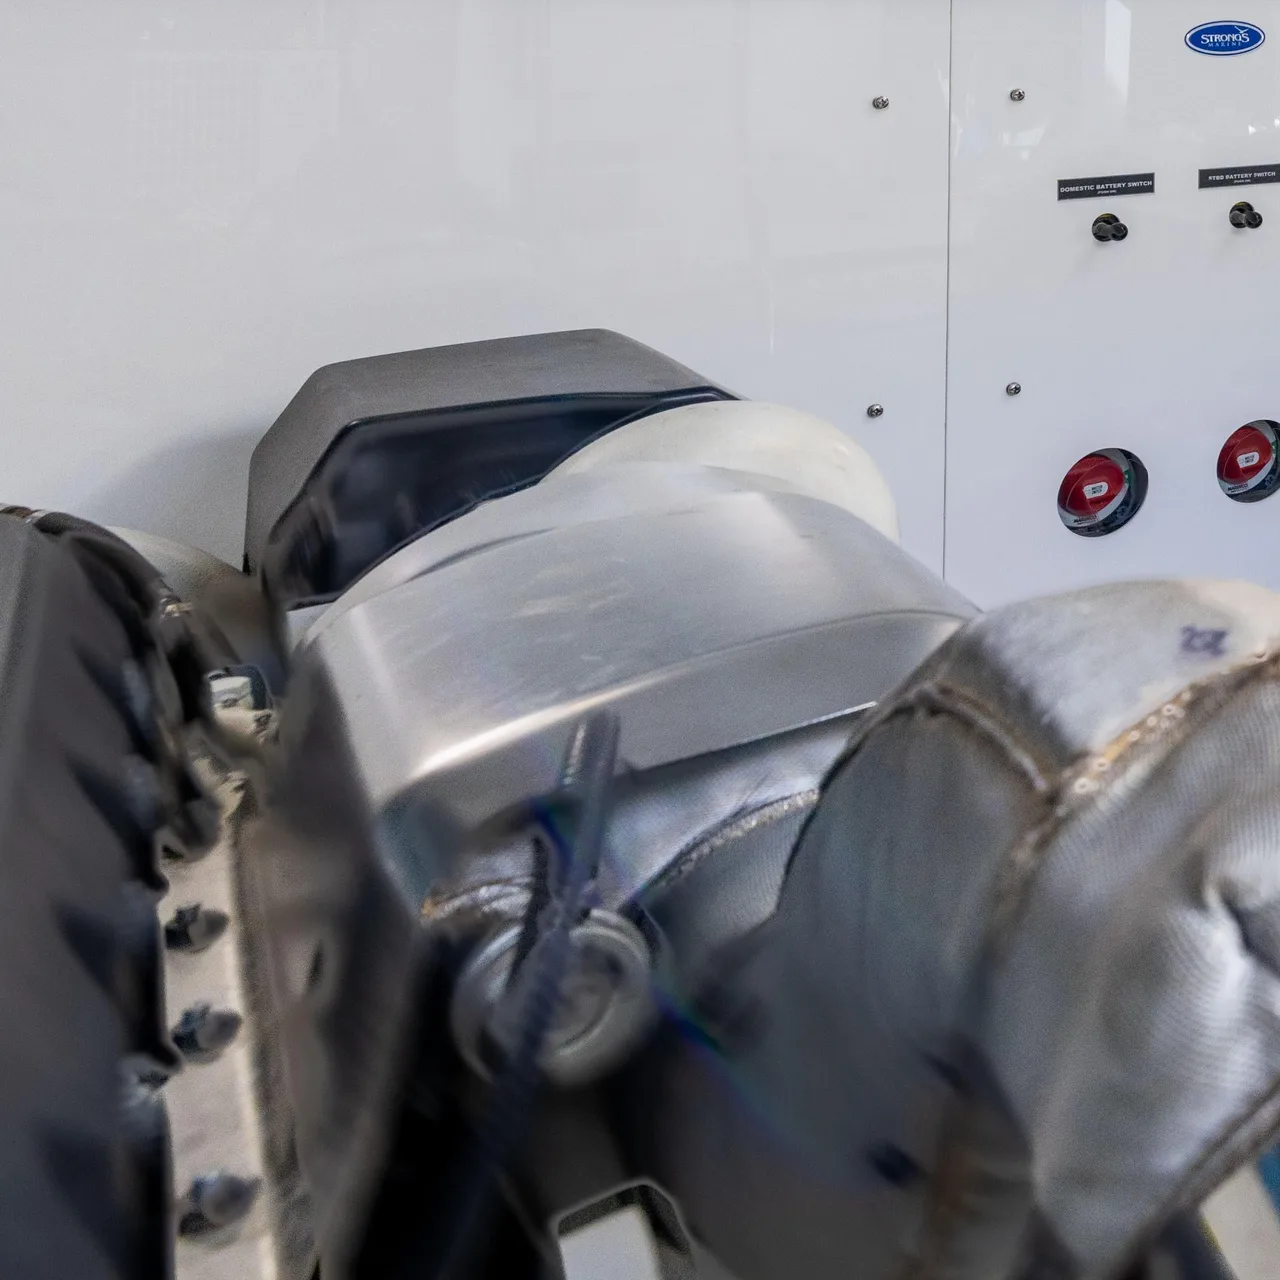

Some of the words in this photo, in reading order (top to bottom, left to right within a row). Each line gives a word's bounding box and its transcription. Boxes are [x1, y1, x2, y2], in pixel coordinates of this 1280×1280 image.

[1225, 172, 1253, 180] BATTERY
[1060, 184, 1095, 193] DOMESTIC
[1096, 182, 1127, 190] BATTERY
[1127, 180, 1153, 188] SWITCH
